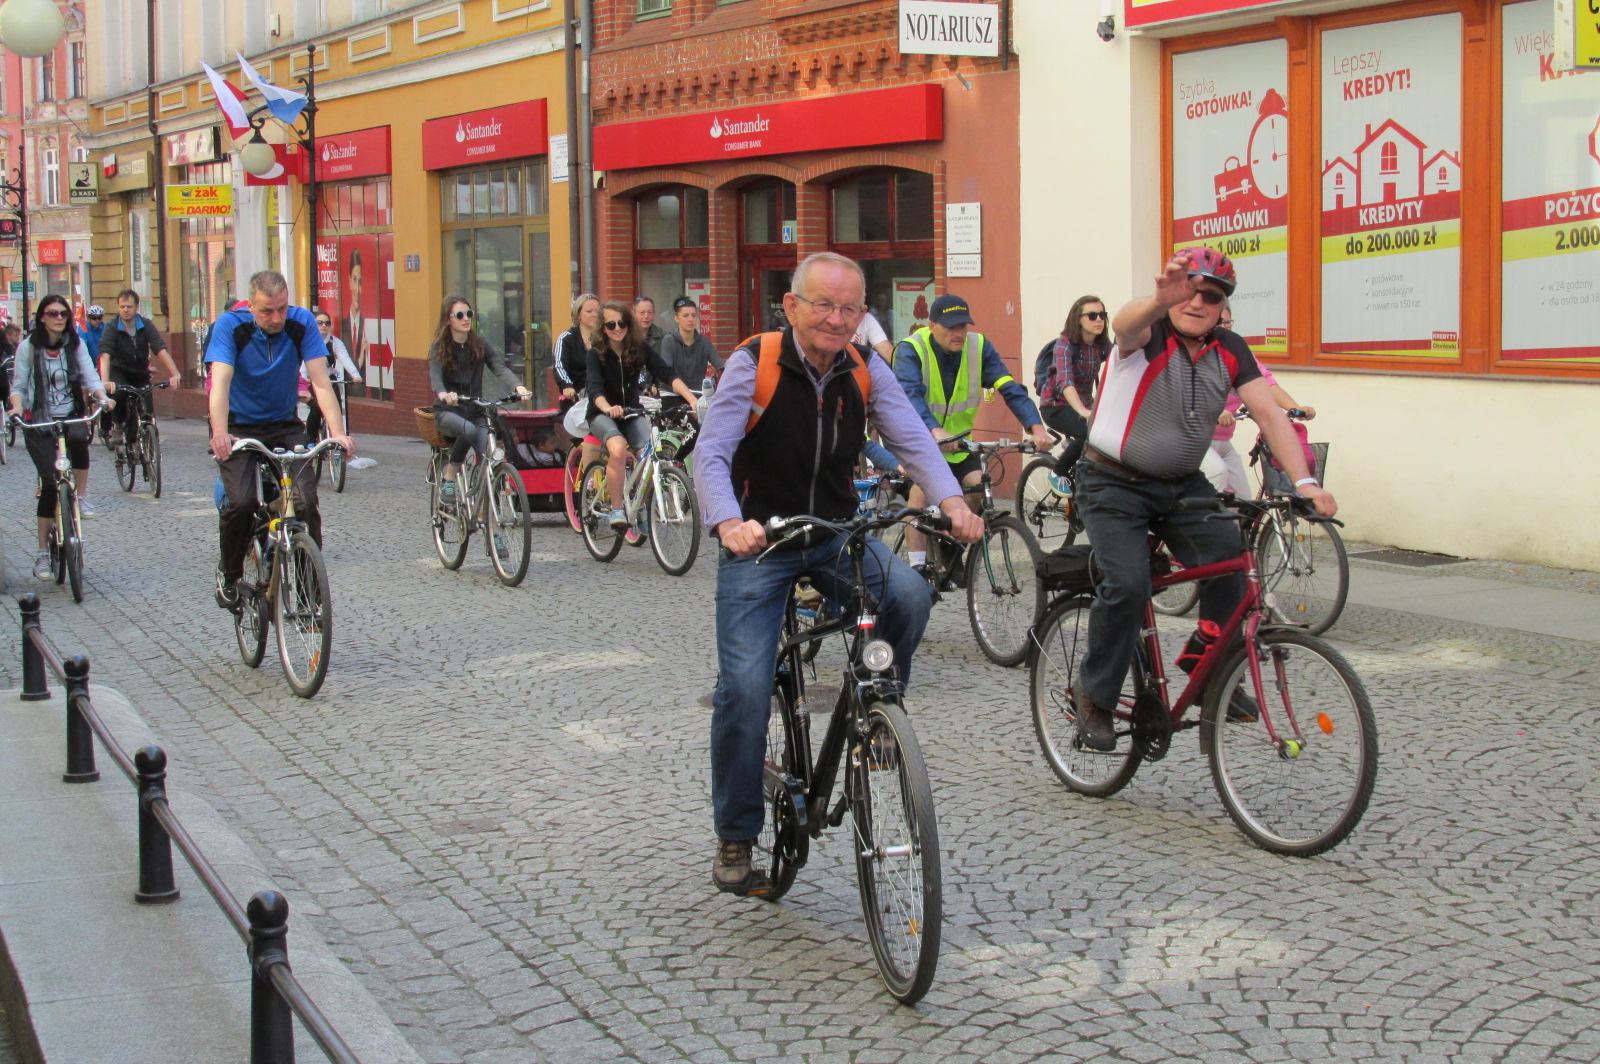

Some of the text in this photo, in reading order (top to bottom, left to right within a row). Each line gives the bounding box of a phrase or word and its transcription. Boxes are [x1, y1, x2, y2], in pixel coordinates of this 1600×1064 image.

[906, 13, 993, 44] NOTARIUSZ
[1333, 49, 1382, 77] Lepszy
[1179, 79, 1215, 102] Szybka
[1343, 68, 1411, 101] KREDYT!
[1186, 90, 1252, 120] GOTÓWKA!
[466, 117, 502, 140] Santander
[723, 113, 770, 136] Santander
[724, 139, 762, 151] CONSUMER BANK
[195, 186, 218, 198] żak
[186, 205, 232, 215] DARMO!
[1359, 200, 1423, 226] KREDYTY
[1193, 209, 1269, 237] CHWILÓWKI
[1250, 234, 1261, 252] zł
[1346, 225, 1437, 255] do 200.000 zł
[317, 243, 337, 266] Wejdź
